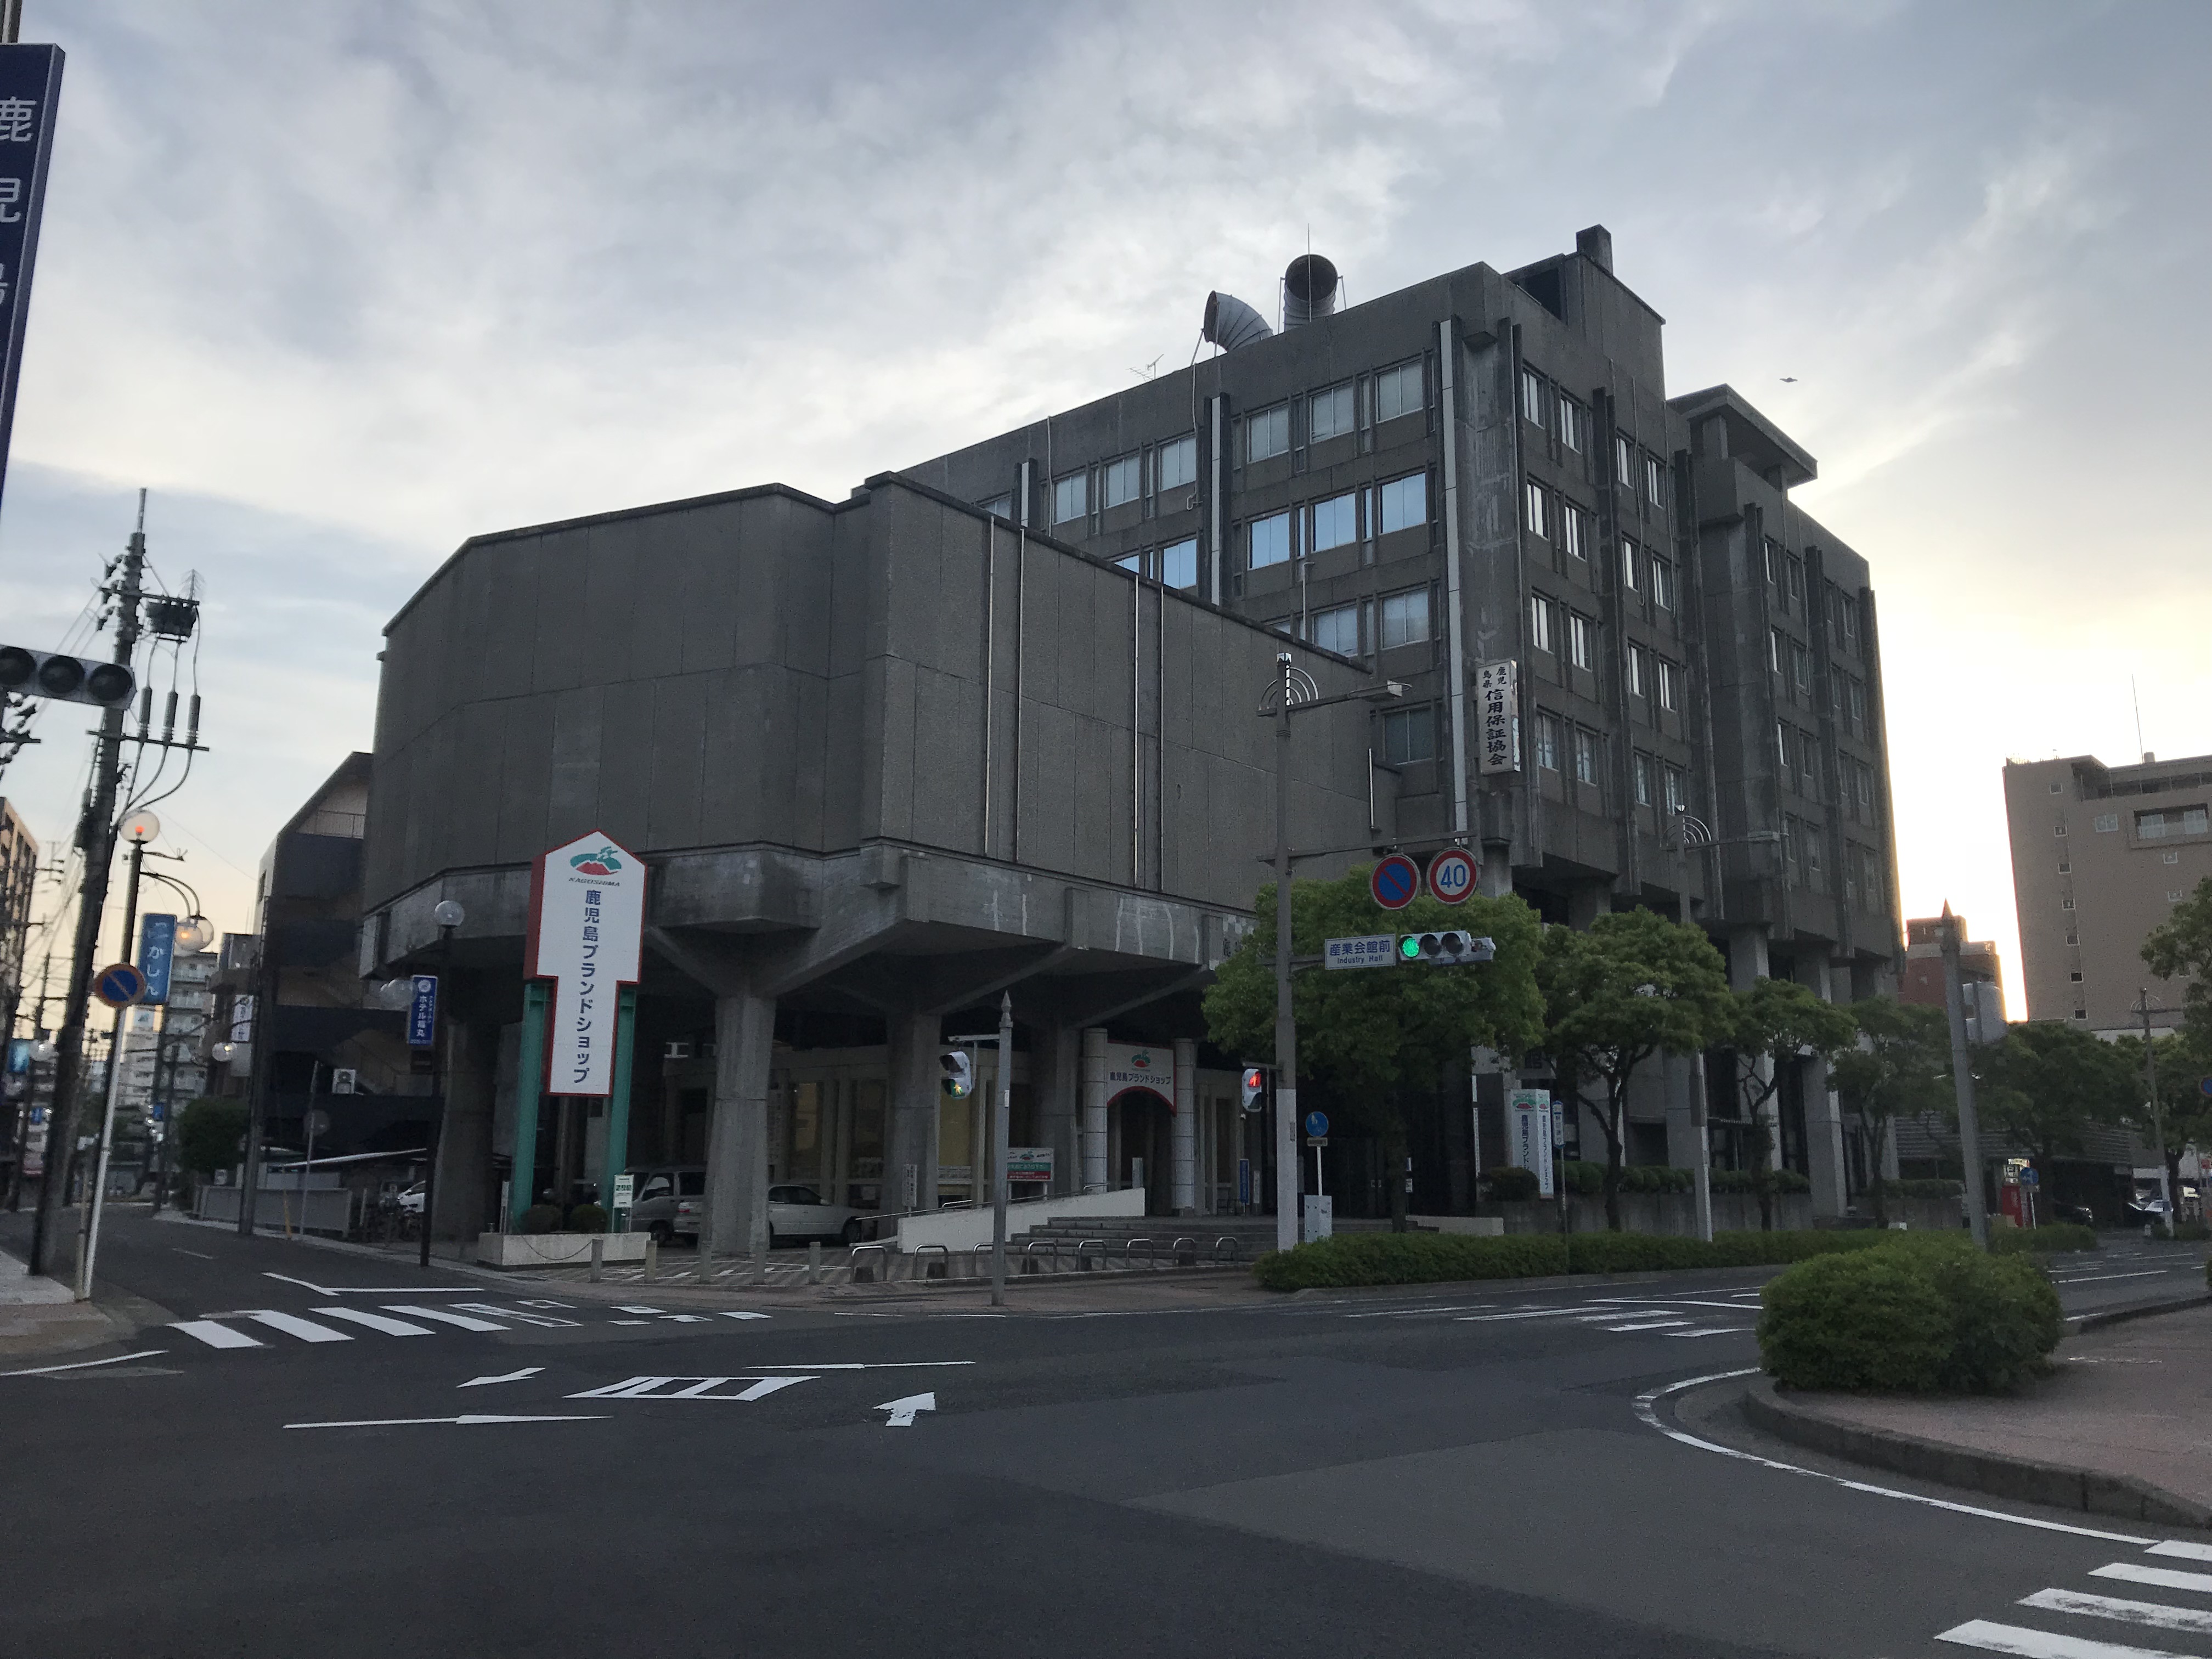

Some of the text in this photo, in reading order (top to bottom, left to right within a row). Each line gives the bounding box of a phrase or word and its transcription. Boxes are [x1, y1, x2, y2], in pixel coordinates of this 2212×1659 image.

[1485, 689, 1507, 765] 信用保証協会
[568, 877, 620, 887] KAGOSHIMA
[1440, 864, 1466, 888] 40
[1330, 940, 1391, 956] 産業会館前
[573, 889, 601, 1084] 鹿児島ブランドショップ
[1110, 1071, 1171, 1084] 鹿児島ブランドショップ
